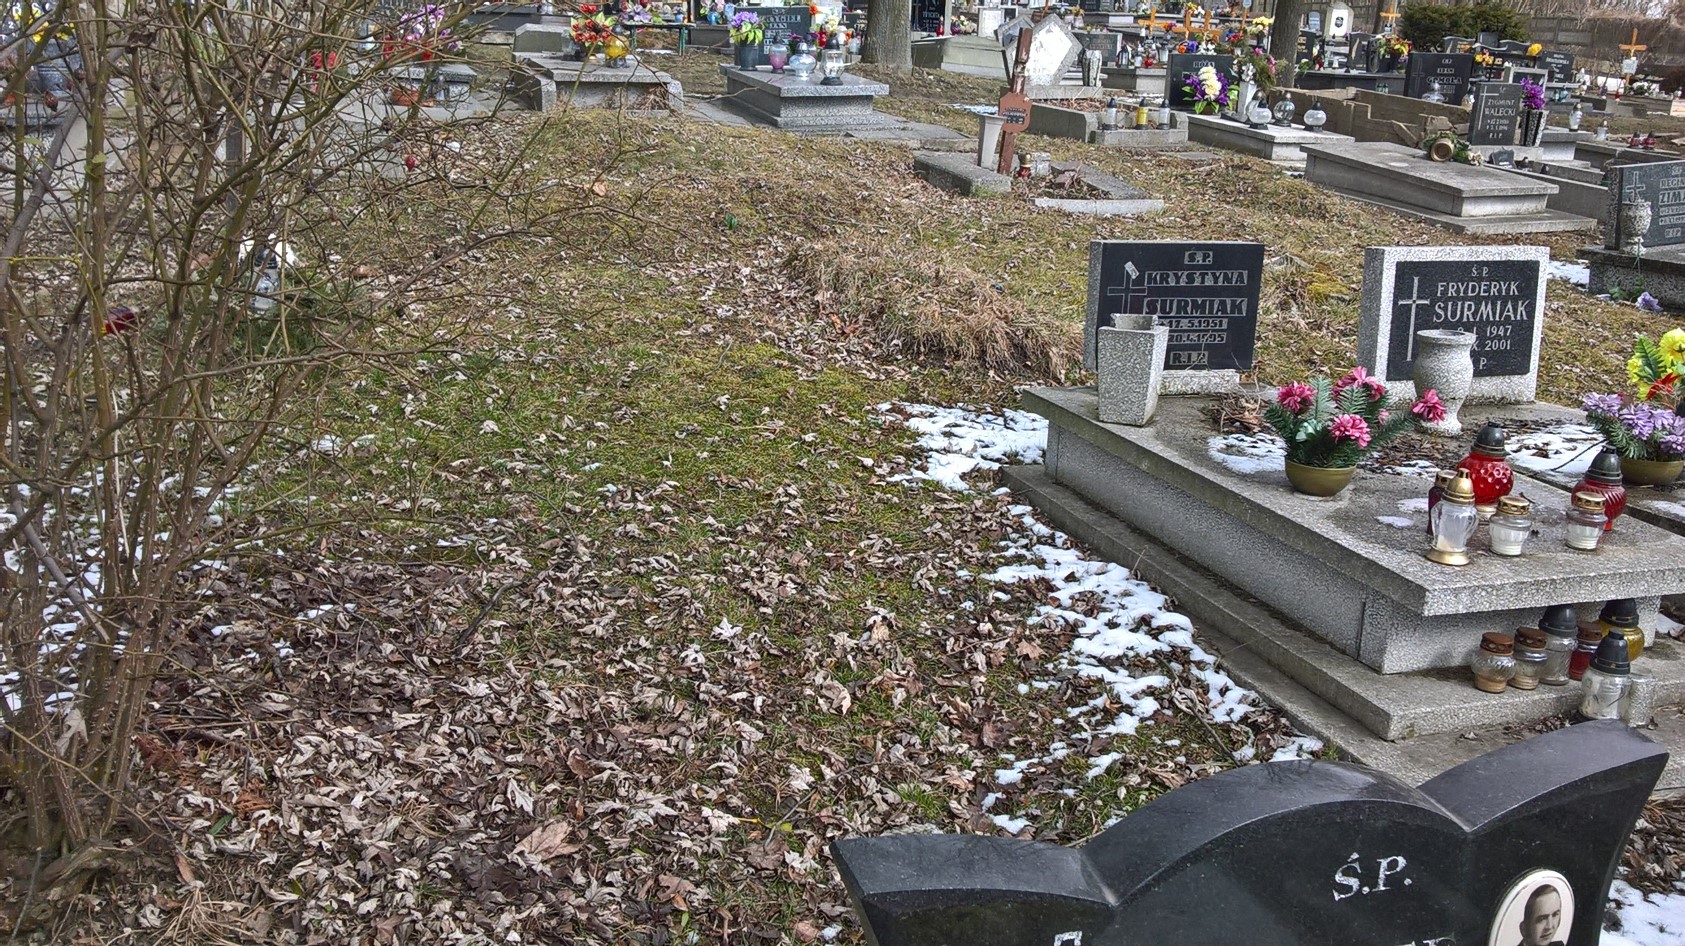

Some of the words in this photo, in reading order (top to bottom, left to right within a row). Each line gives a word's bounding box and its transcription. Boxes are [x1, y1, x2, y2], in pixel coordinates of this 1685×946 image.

[1485, 107, 1516, 116] WALECKI
[1146, 271, 1247, 286] KRYSTYNA
[1436, 281, 1520, 297] FRYDERYK
[1145, 298, 1245, 316] SURMIAK
[1432, 300, 1531, 323] SURMIAK
[1486, 325, 1512, 338] 1947
[1484, 339, 1511, 351] 2001
